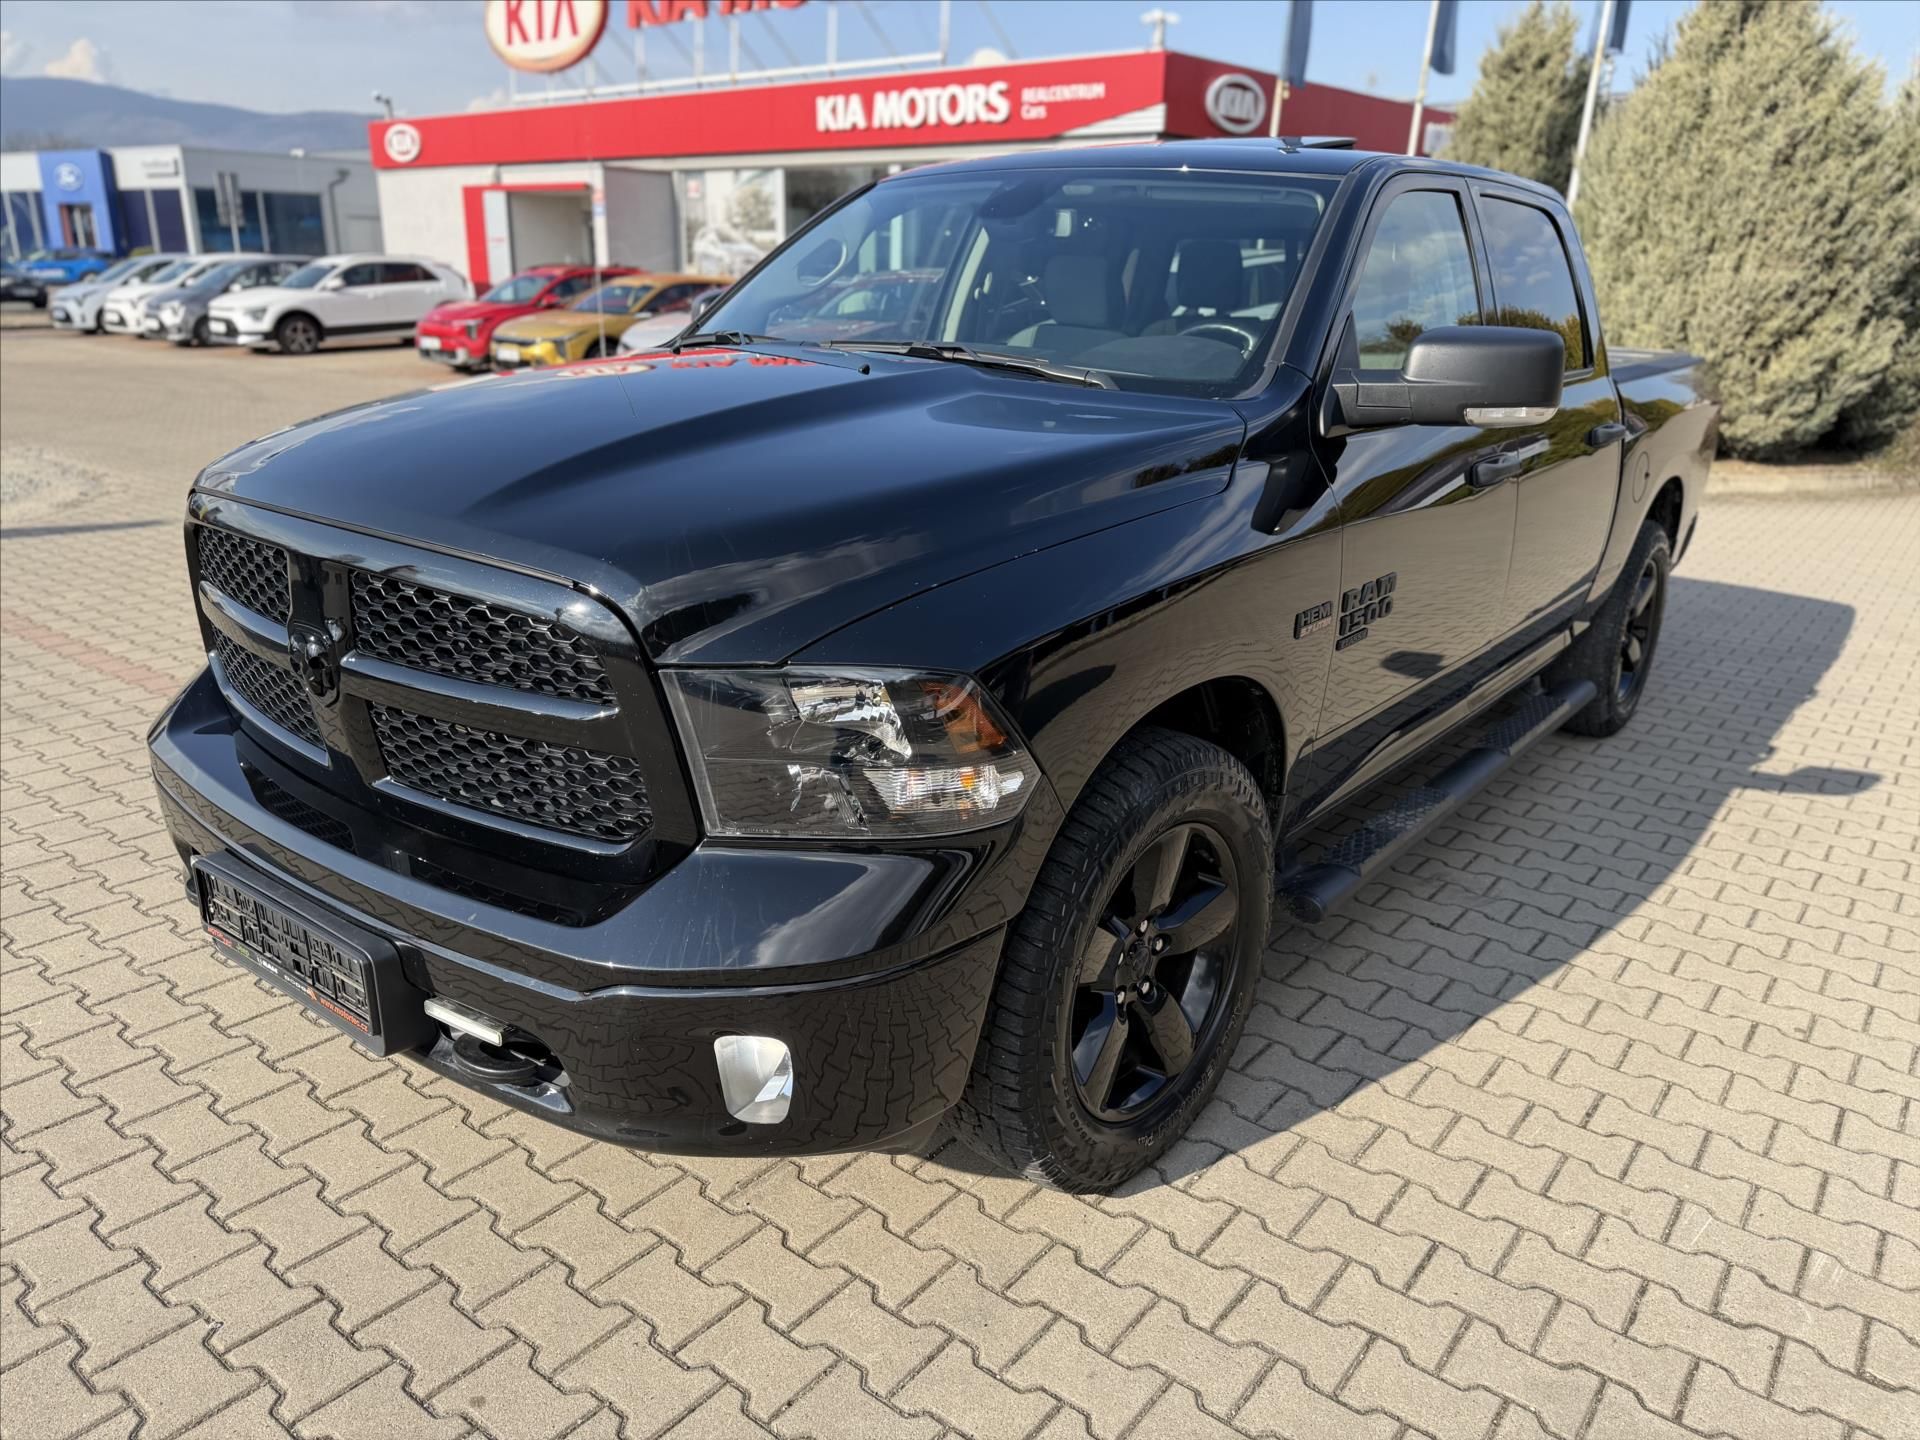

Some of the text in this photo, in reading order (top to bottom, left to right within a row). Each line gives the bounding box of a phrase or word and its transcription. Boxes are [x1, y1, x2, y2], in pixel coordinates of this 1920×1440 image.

[815, 81, 1010, 131] KIA MOTORS
[1021, 82, 1106, 103] REALCENTRUM
[1341, 571, 1397, 613] RAM
[1339, 595, 1393, 636] 1500
